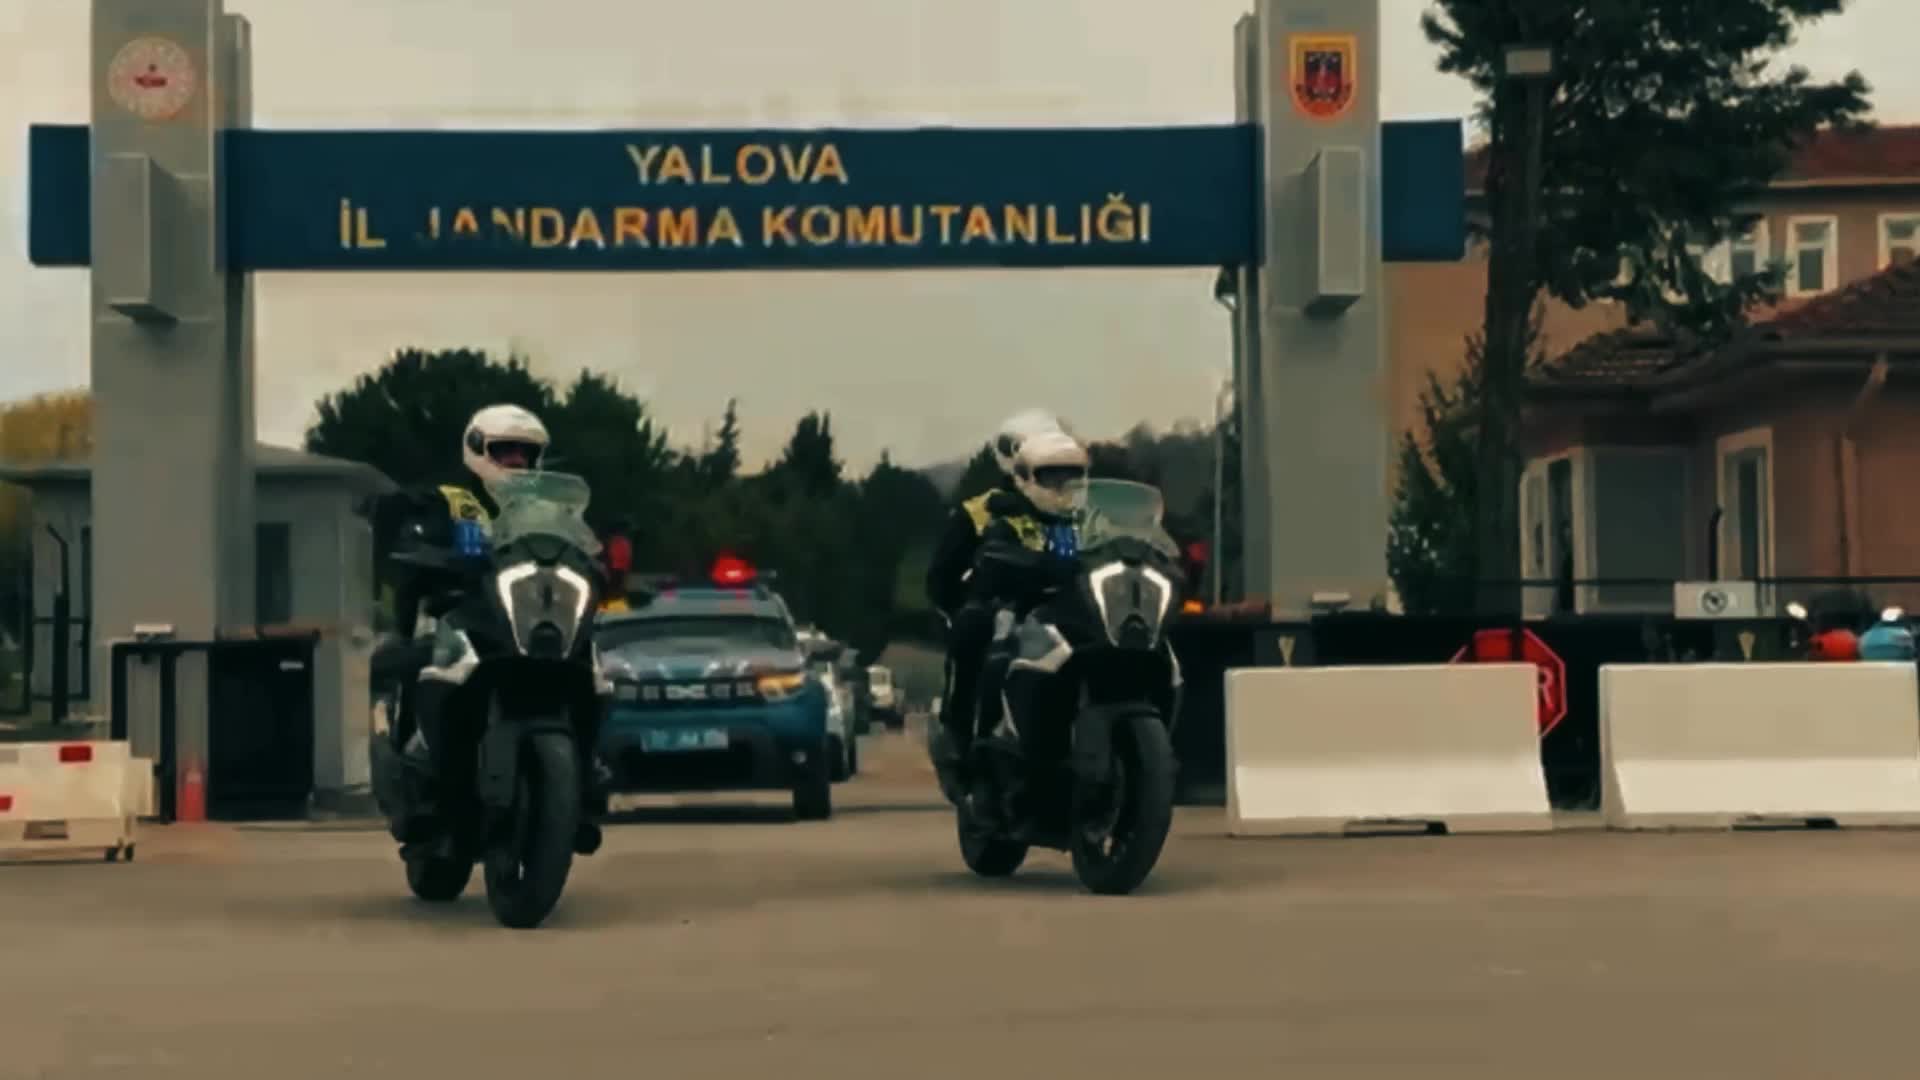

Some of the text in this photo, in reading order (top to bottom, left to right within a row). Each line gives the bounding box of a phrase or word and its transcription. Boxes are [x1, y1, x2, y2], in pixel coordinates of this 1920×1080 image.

[626, 143, 848, 185] YALOVA
[338, 197, 387, 248] İL
[761, 192, 1152, 246] KOMUTANLIĞI
